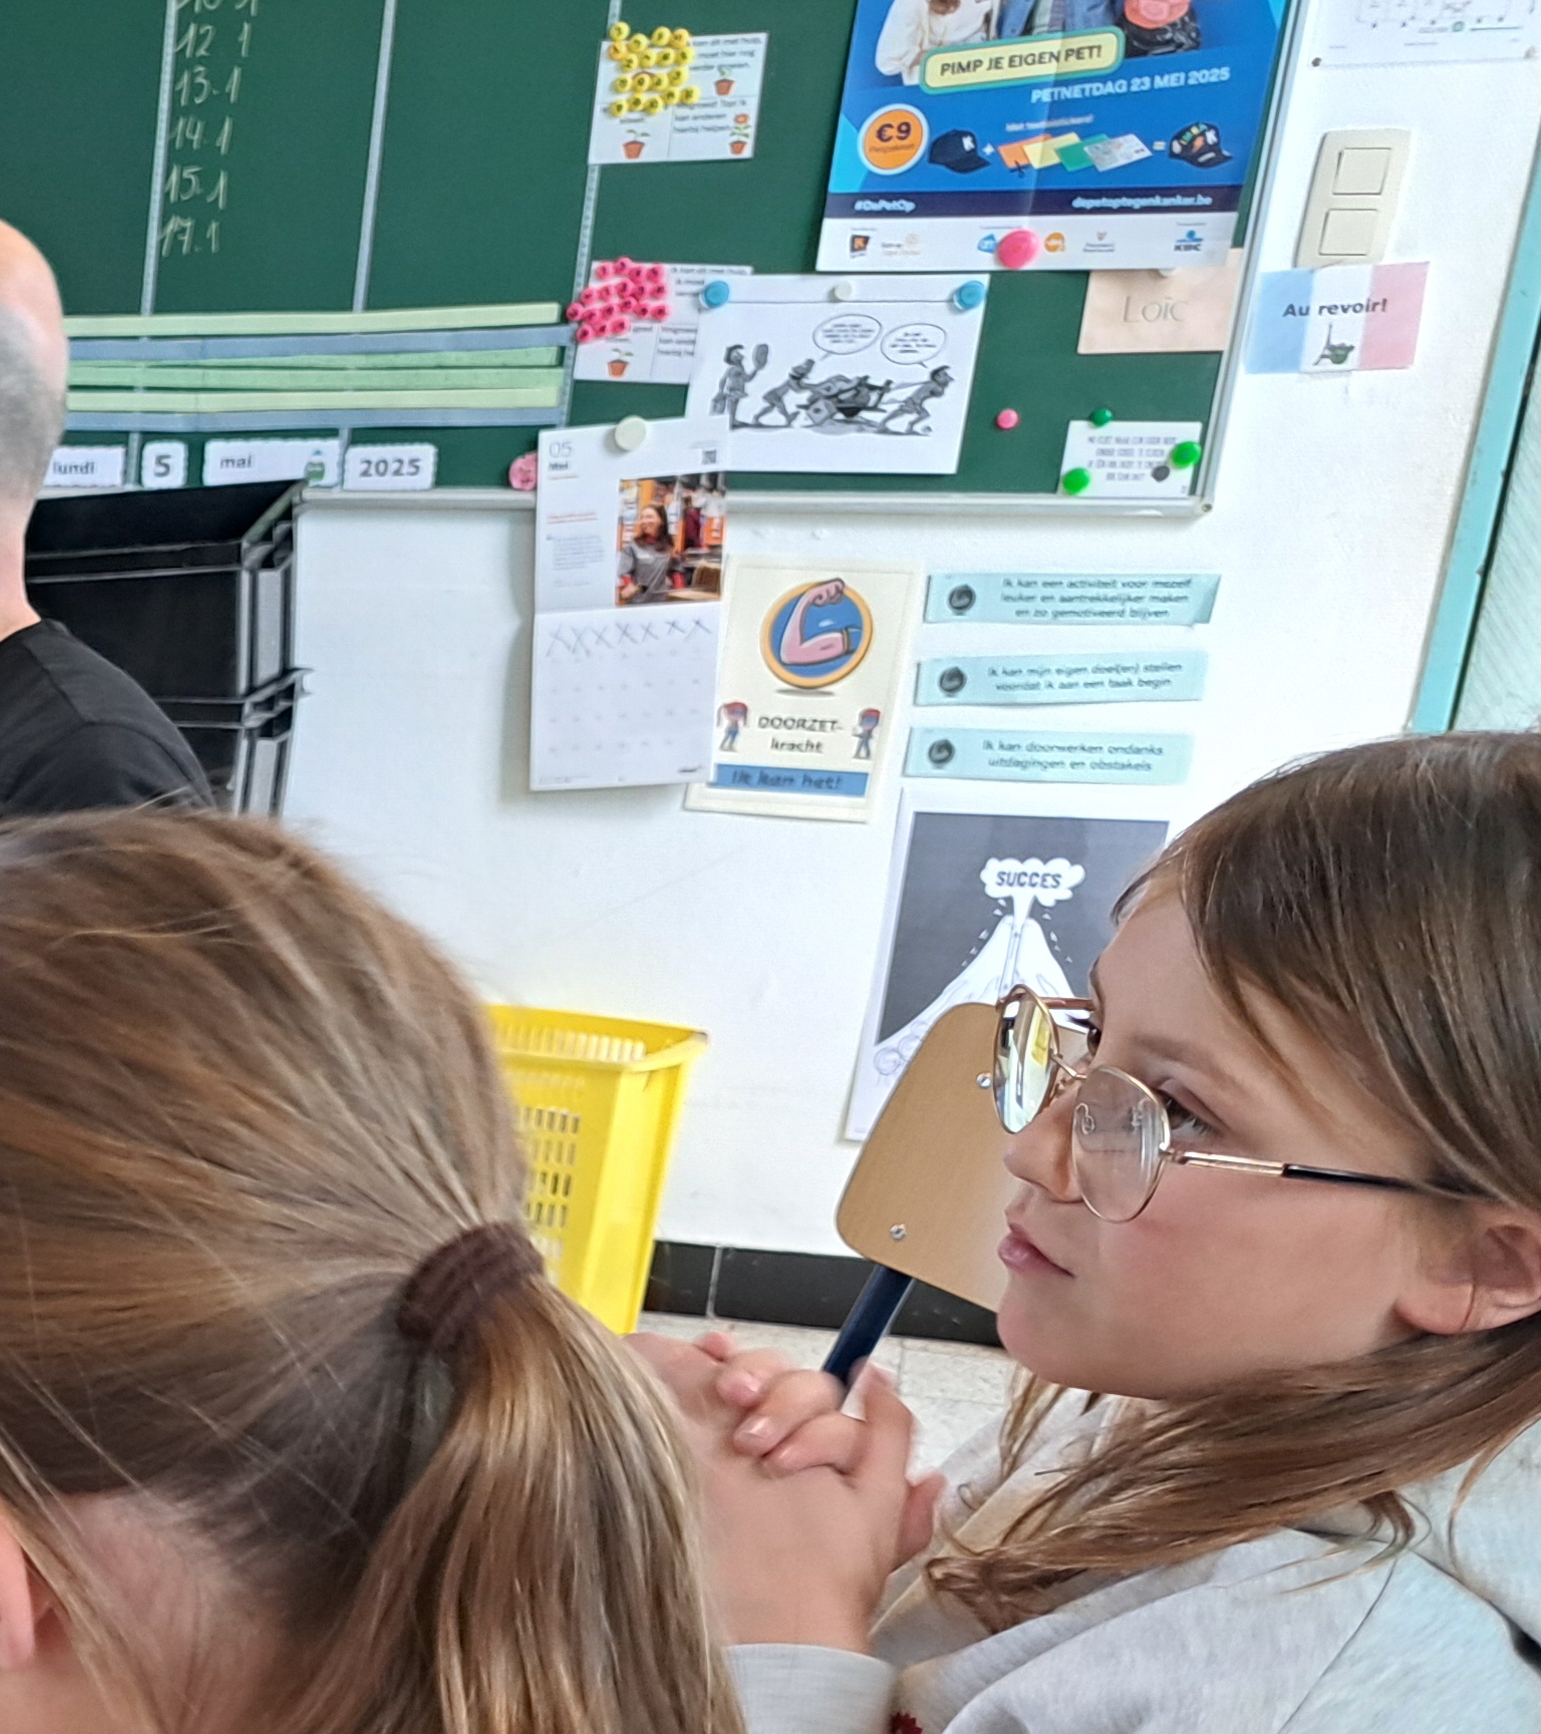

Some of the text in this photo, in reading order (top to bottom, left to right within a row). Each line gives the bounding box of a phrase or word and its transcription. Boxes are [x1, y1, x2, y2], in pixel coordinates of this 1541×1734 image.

[939, 44, 1102, 77] PIMP JE EIGEN PET!
[1030, 66, 1231, 103] PETNETDAG 23 MEI 2025
[876, 121, 912, 143] €9
[1282, 297, 1388, 318] Au revoir!
[53, 453, 422, 478] lundi 5 mai 2025
[995, 870, 1063, 890] SUCCES
